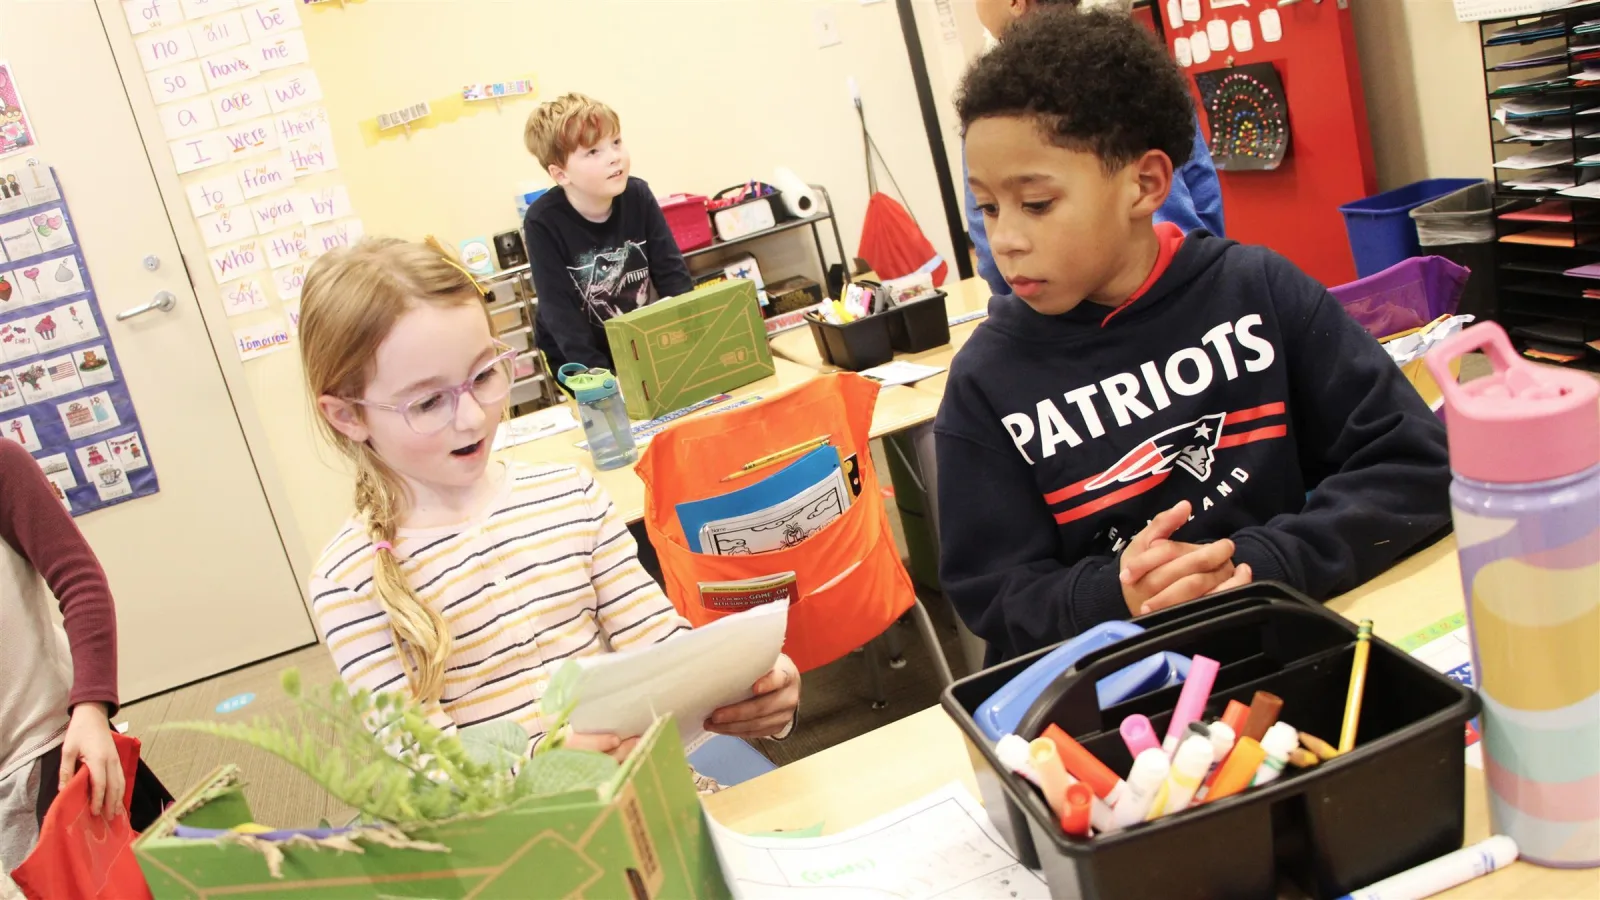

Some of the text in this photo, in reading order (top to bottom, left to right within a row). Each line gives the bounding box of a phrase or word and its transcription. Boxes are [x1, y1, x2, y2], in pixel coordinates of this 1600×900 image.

[142, 0, 160, 20] of
[256, 8, 284, 30] be
[207, 23, 229, 42] all
[151, 39, 178, 59] no
[262, 43, 289, 61] me
[207, 59, 249, 79] have
[164, 75, 186, 93] so
[275, 80, 306, 103] we
[221, 91, 252, 112] are
[178, 109, 197, 126] a
[226, 126, 266, 149] were
[281, 118, 315, 139] their
[186, 139, 211, 164] I
[289, 149, 324, 168] they
[244, 169, 282, 189] from
[201, 186, 224, 207] to
[257, 199, 294, 222] word
[310, 197, 334, 217] by
[215, 220, 232, 234] is
[271, 238, 307, 258] the
[322, 231, 348, 251] my
[215, 250, 255, 274] who
[239, 331, 289, 352] tomorrow
[1000, 313, 1275, 465] PATRIOTS
